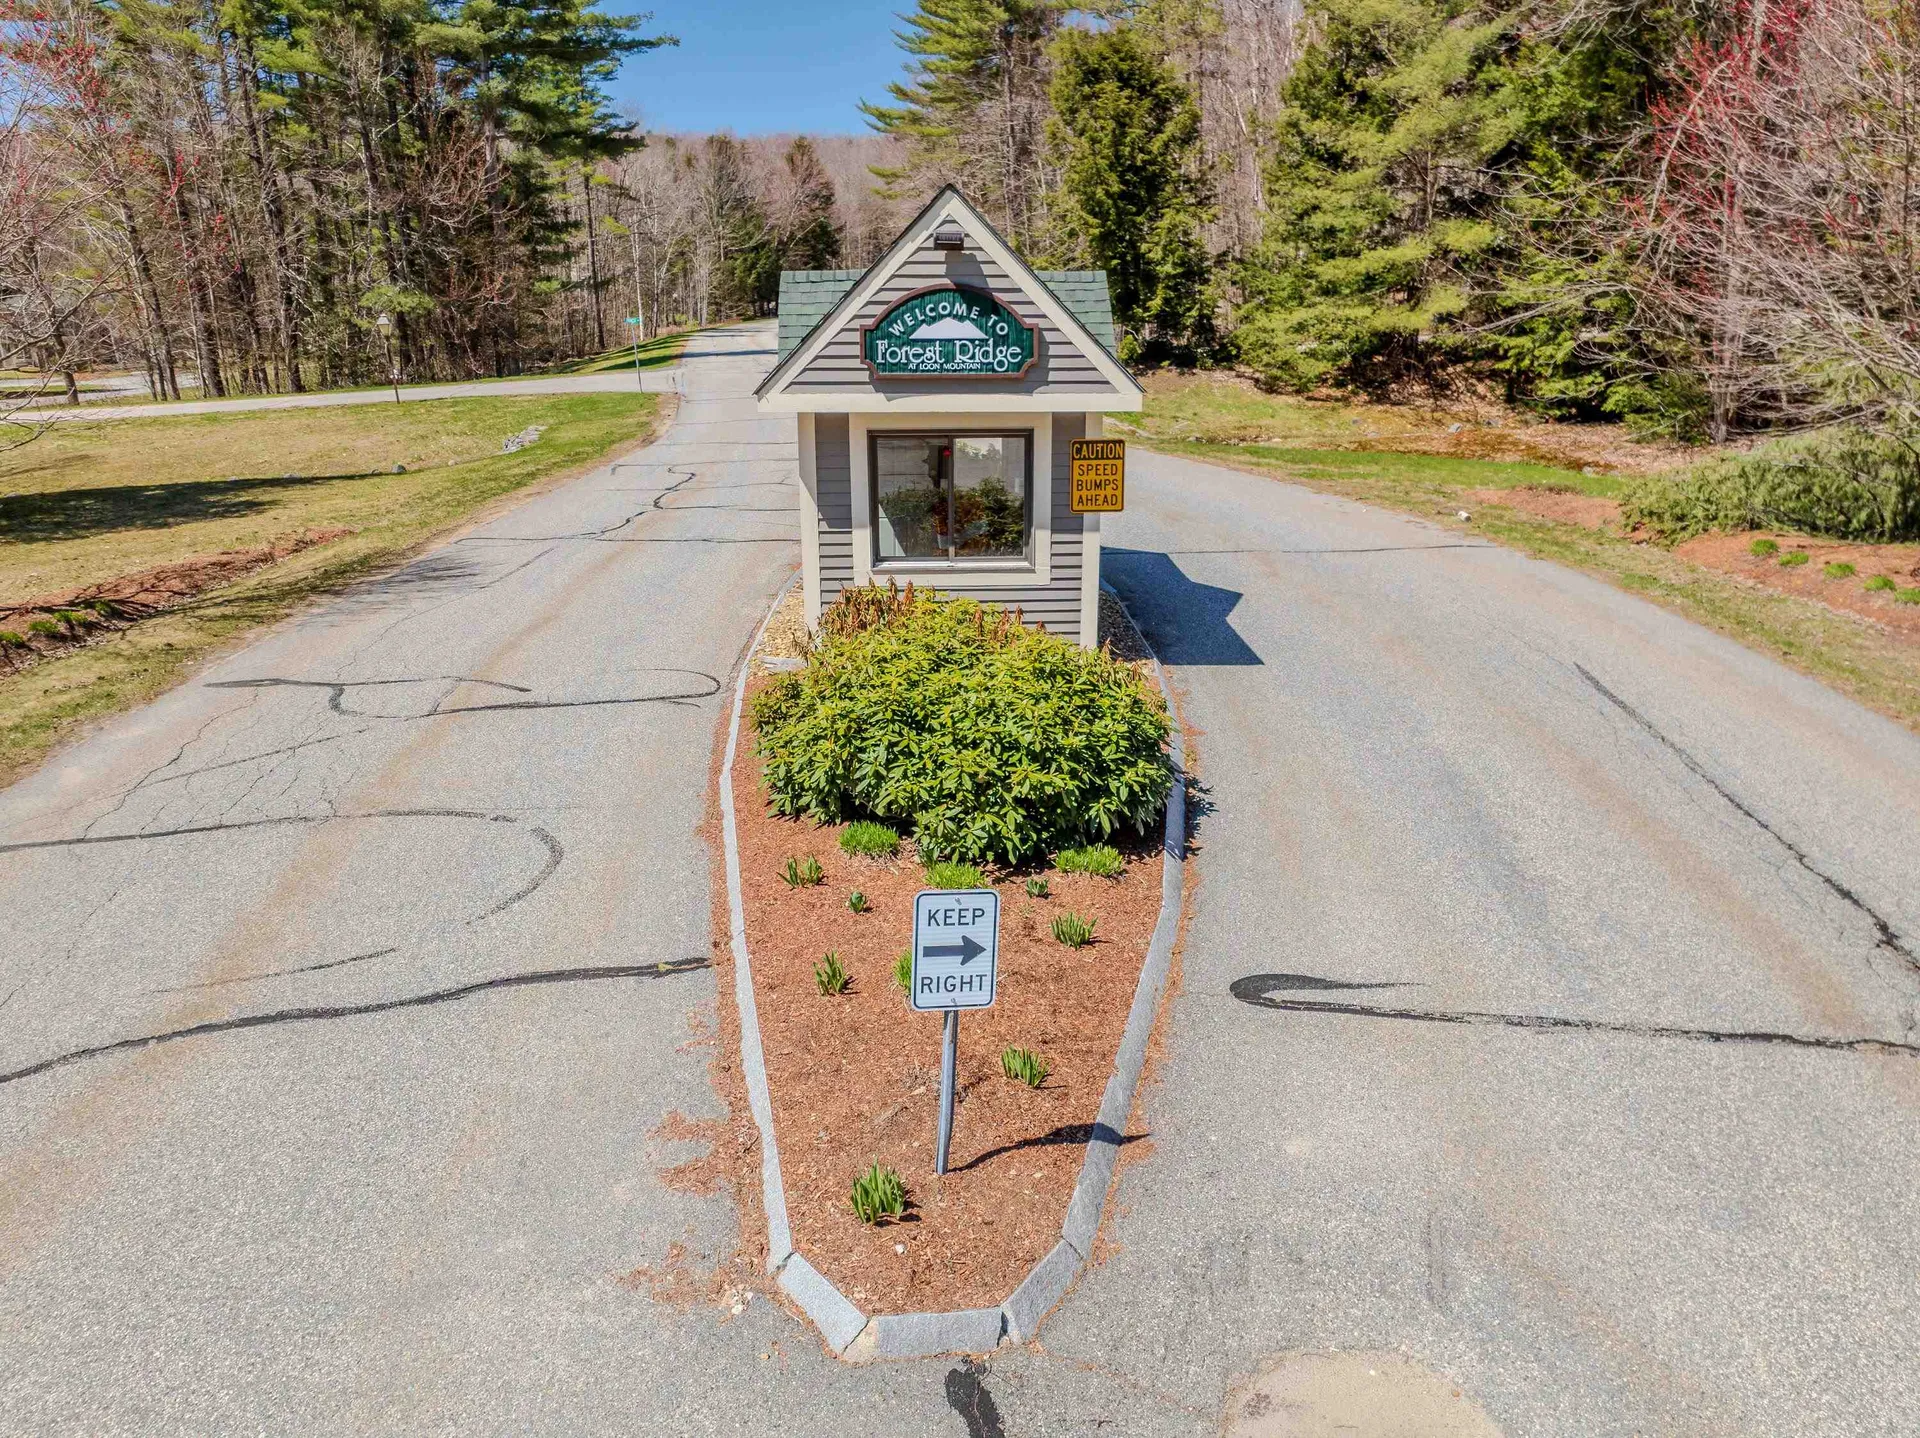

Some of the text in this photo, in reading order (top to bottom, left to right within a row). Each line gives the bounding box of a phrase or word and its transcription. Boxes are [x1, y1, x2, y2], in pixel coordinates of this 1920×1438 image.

[889, 302, 1009, 337] WELCOME TO
[876, 337, 1022, 372] Forest Ridge
[1073, 443, 1123, 459] CAUTION
[1078, 463, 1118, 476] SPEED
[1076, 479, 1119, 491] BUMPS
[1077, 494, 1118, 507] AHEAD
[927, 908, 986, 927] KEEP
[920, 974, 988, 994] RIGHT
